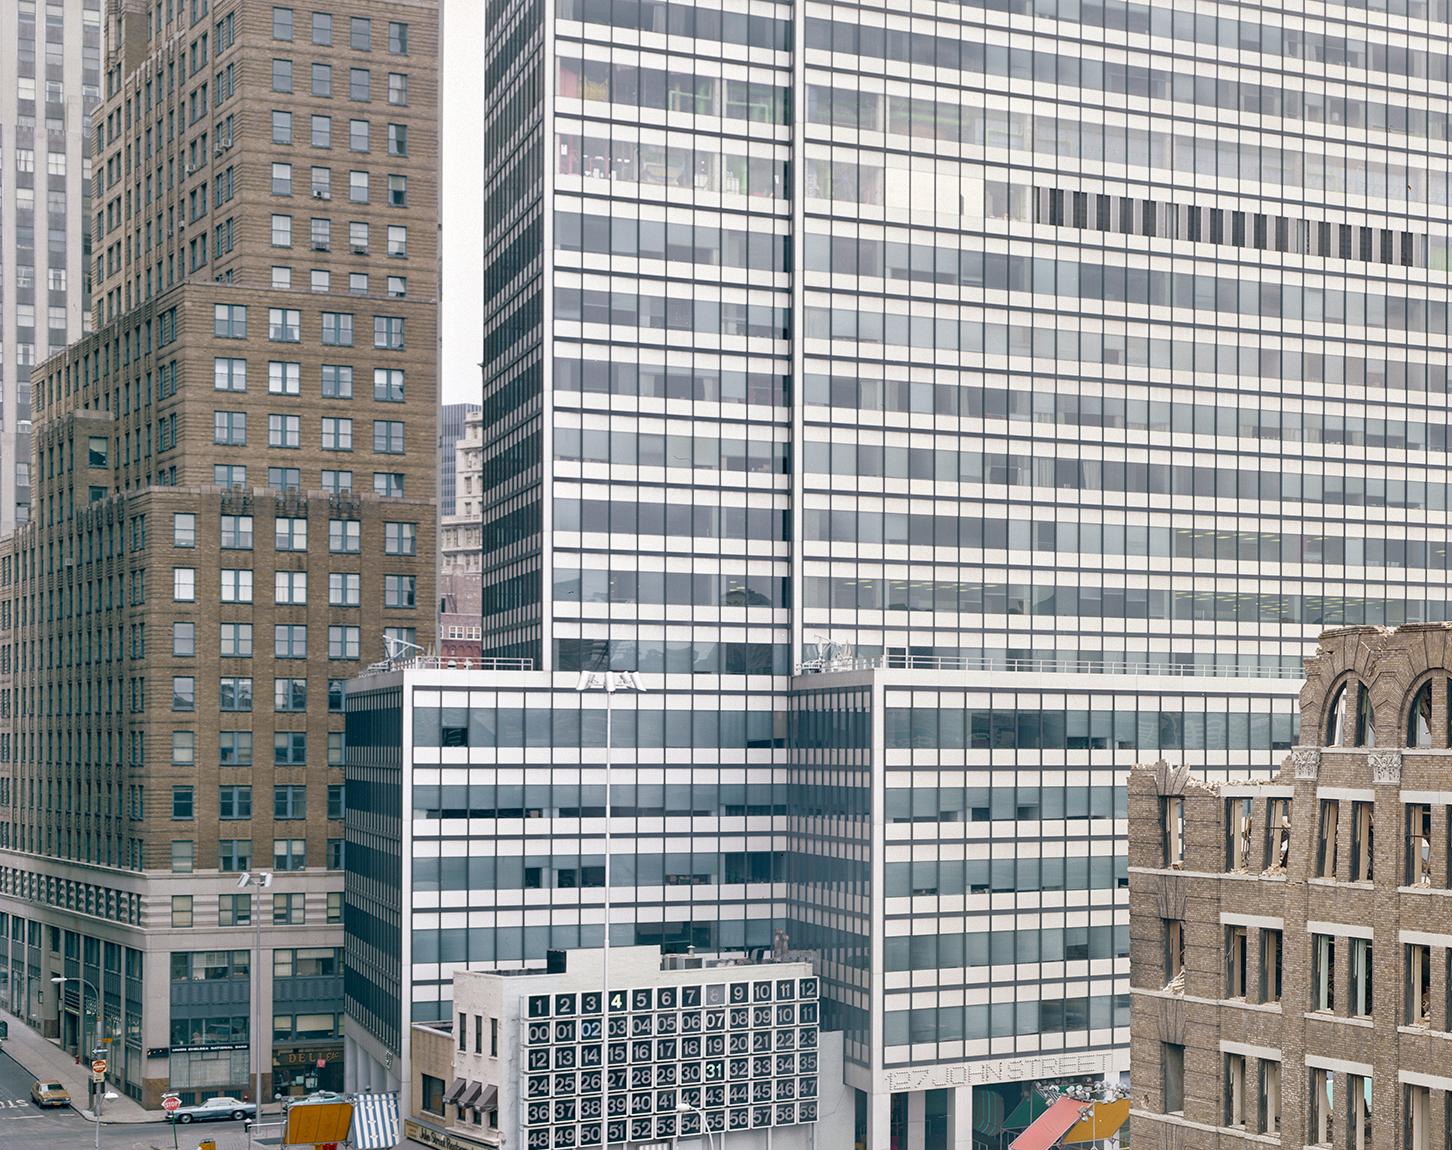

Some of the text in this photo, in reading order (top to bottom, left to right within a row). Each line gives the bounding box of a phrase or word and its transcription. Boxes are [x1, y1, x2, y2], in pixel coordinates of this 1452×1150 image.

[536, 1000, 541, 1013] 1
[560, 998, 570, 1012] 2
[586, 997, 596, 1010] 3
[611, 994, 622, 1008] 4
[637, 993, 646, 1006] 5
[662, 992, 671, 1005] 6
[687, 990, 695, 1003] 7
[735, 987, 743, 1000] 9
[755, 985, 769, 999] 10
[781, 984, 790, 997] 11
[801, 982, 815, 995] 12
[529, 1007, 812, 1040] 00 01 02 03 04 05 06 07 08 09 10 11
[531, 1031, 816, 1067] 12 13 14 15 16 17 18 19 20 21 22 23
[529, 1055, 816, 1094] 24 25 26 27 28 29 30 31 32 33 34 35
[885, 1053, 1113, 1091] 127 JOHN STREET
[529, 1081, 816, 1120] 36 37 38 39 40 41 42 43 44 45 46 47
[529, 1105, 816, 1147] 48 49 50 51 52 53 54 55 56 57 58 59
